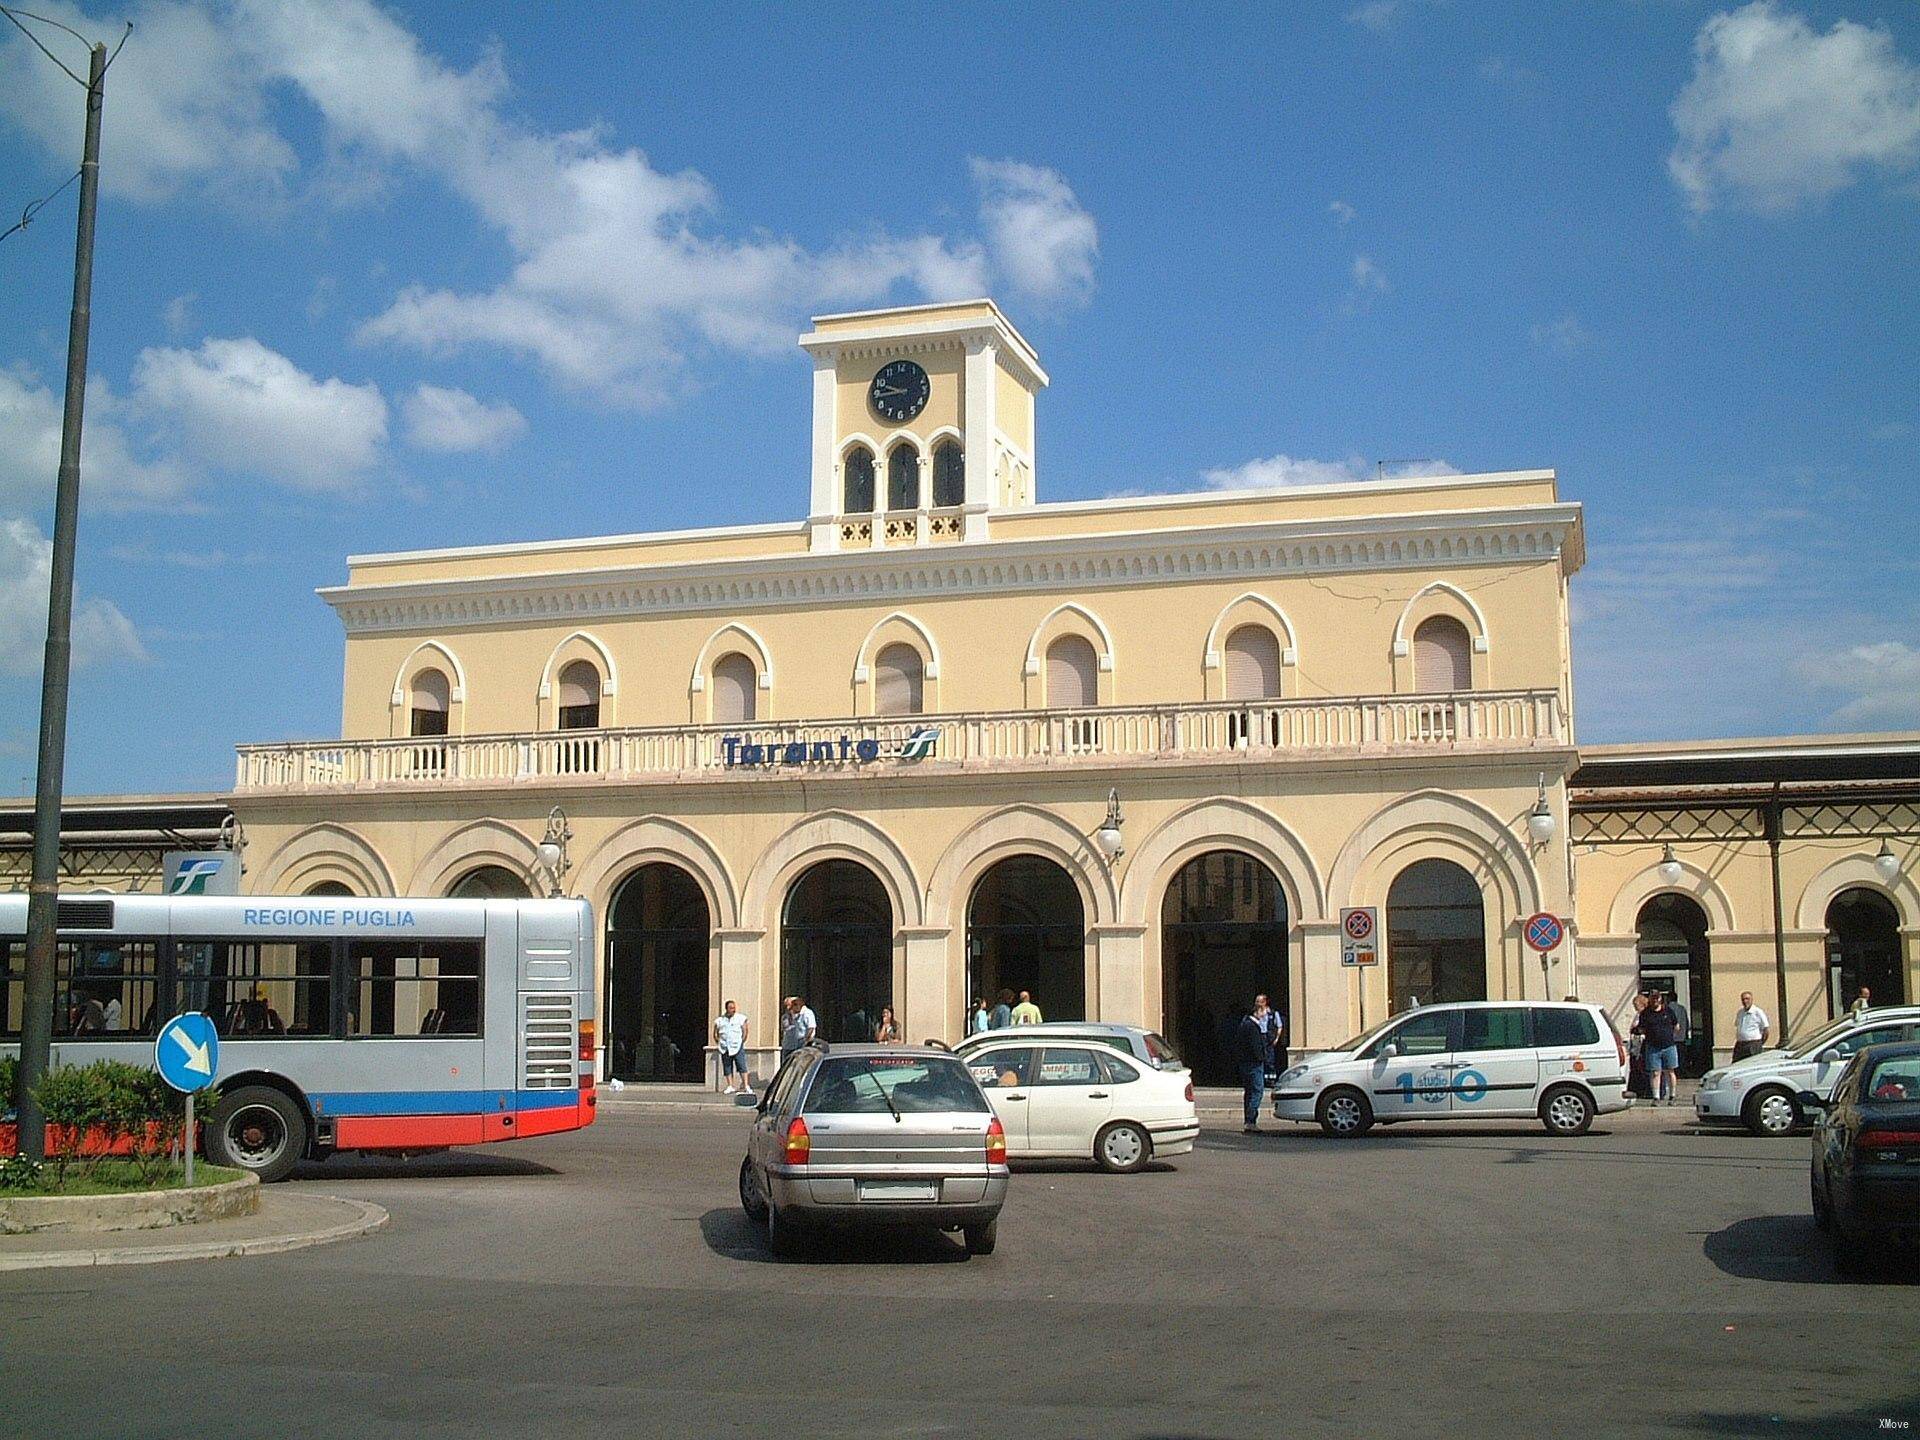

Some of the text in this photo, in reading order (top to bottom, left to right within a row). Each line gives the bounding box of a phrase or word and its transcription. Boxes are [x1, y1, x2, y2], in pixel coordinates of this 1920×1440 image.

[886, 369, 893, 377] 11
[897, 364, 906, 373] 12
[876, 379, 886, 387] 10
[722, 736, 879, 767] Taranto
[244, 909, 416, 927] REGIONE PUGLIA
